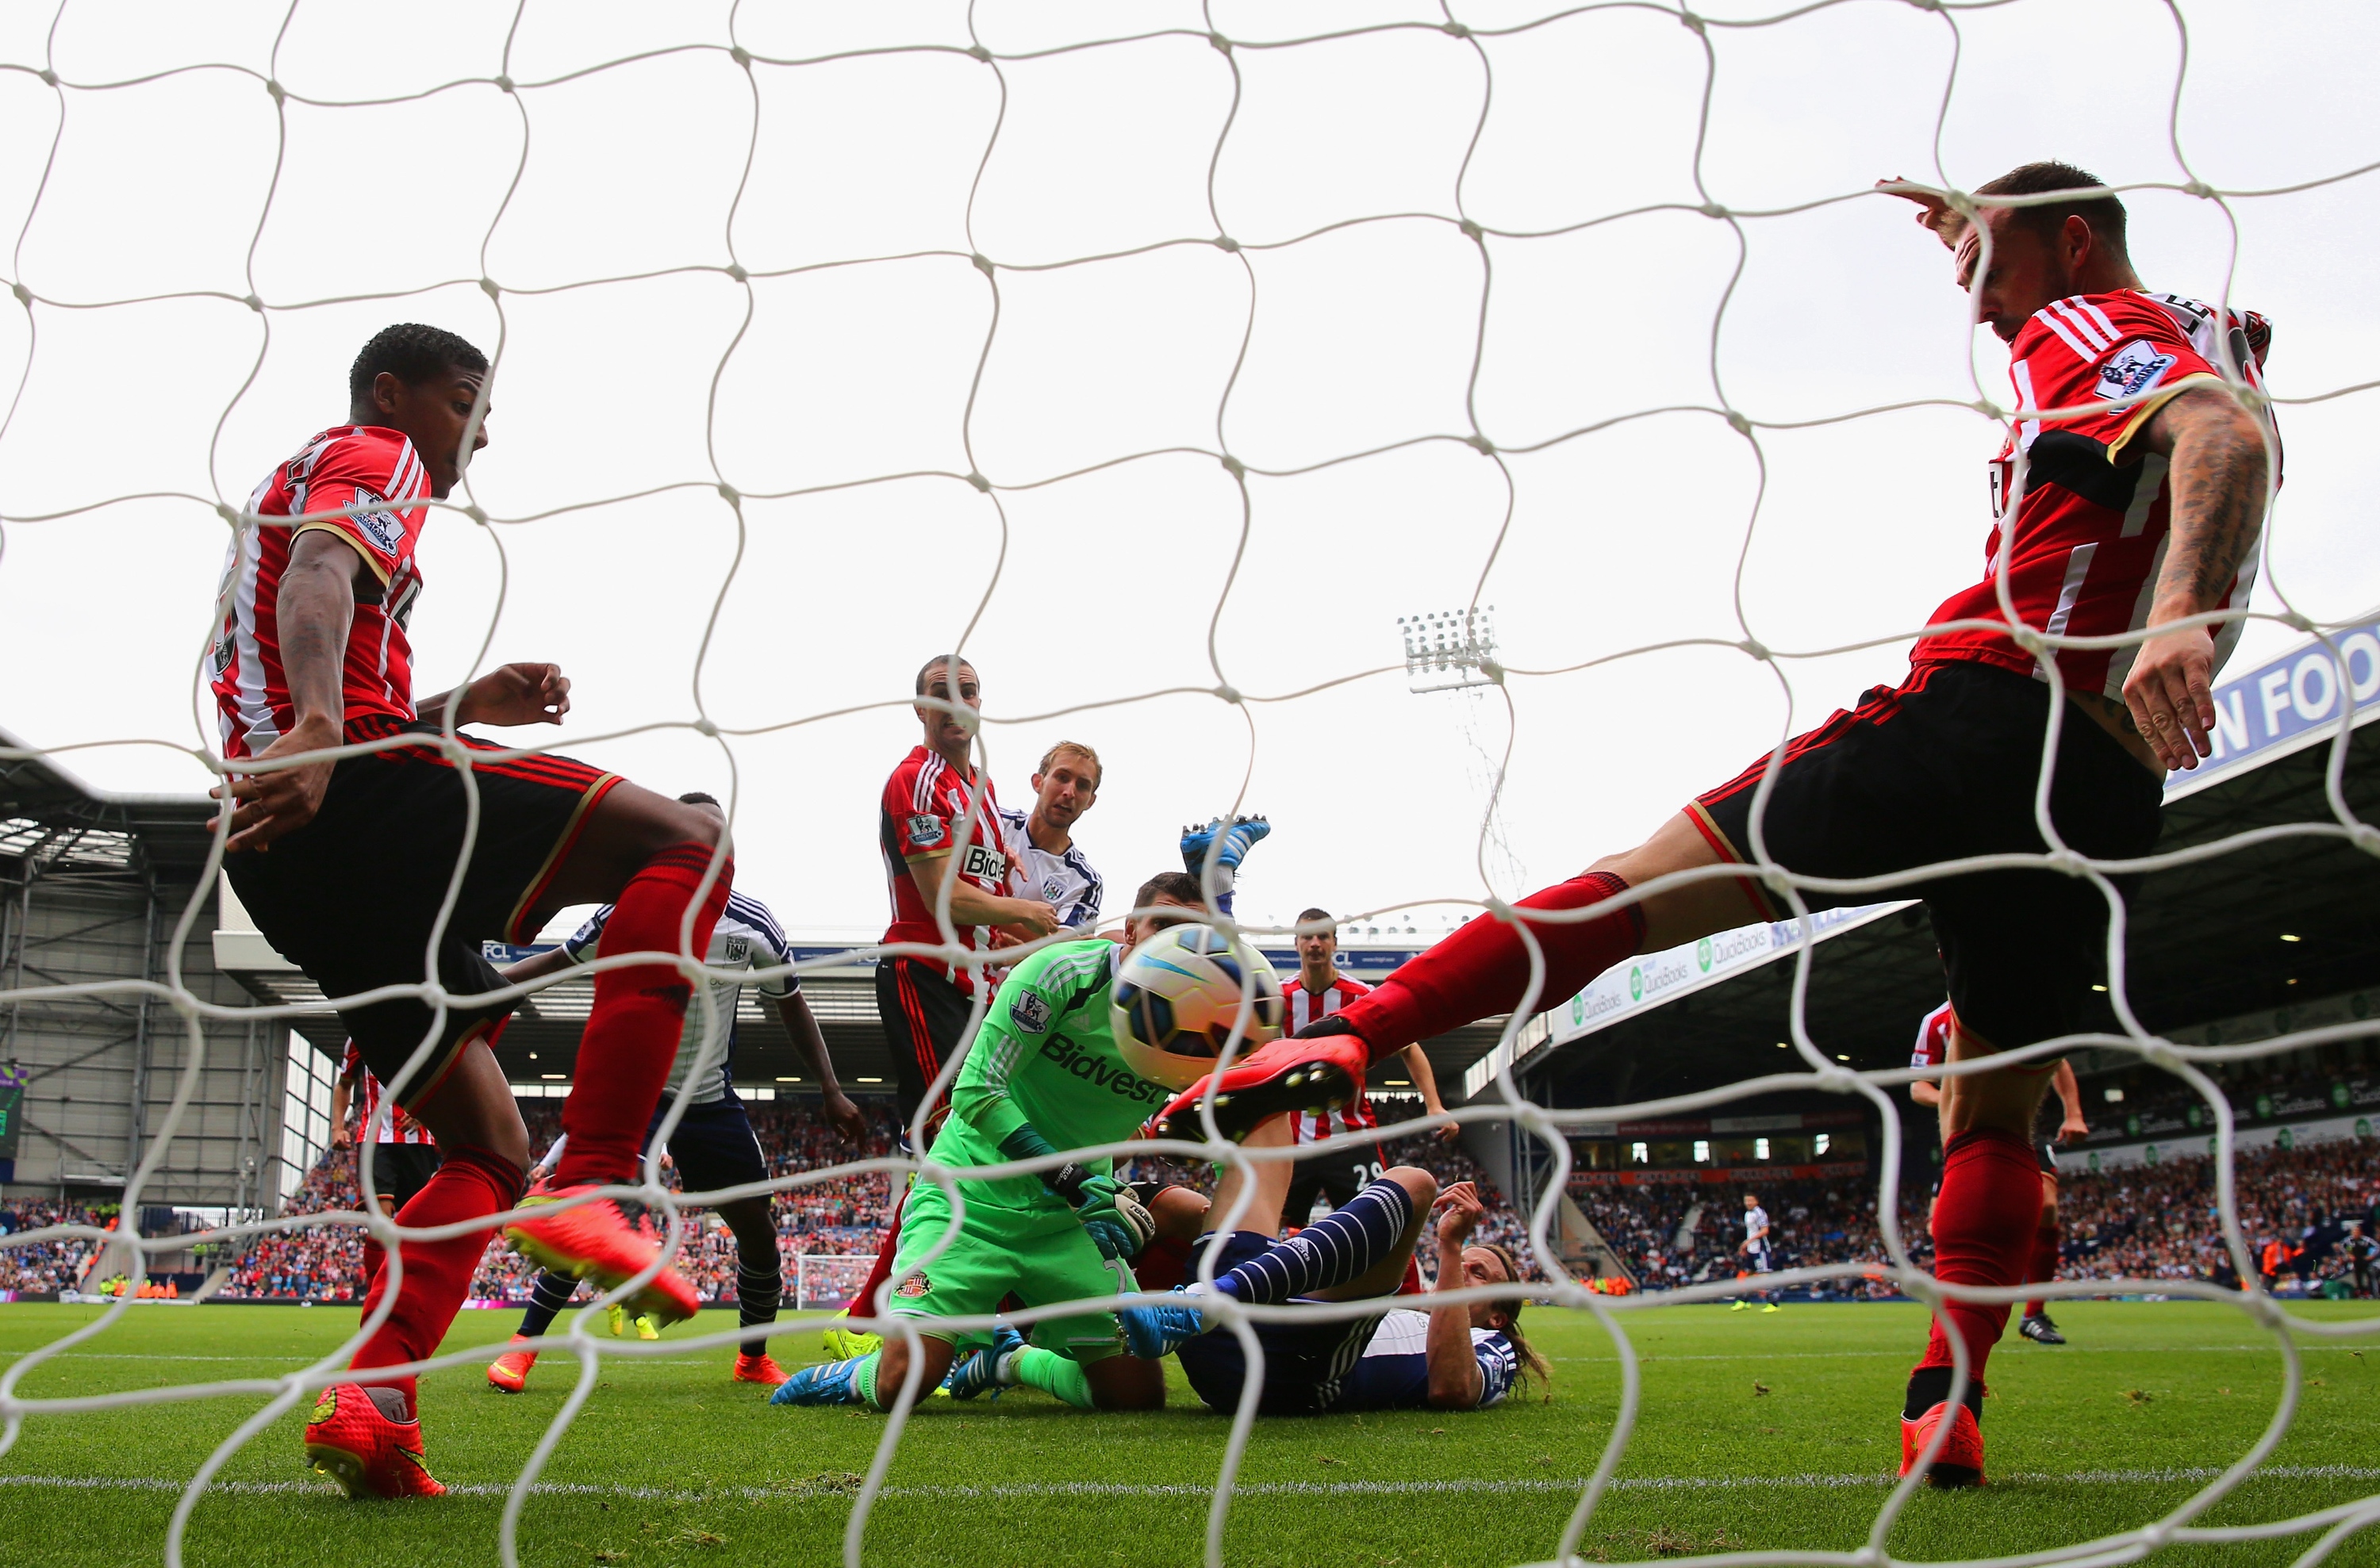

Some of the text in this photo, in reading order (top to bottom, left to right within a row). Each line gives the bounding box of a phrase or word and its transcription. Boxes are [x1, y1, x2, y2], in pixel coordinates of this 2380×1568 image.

[483, 944, 512, 959] FCL
[1330, 951, 1353, 967] CL
[1040, 1031, 1161, 1105] Bidvest
